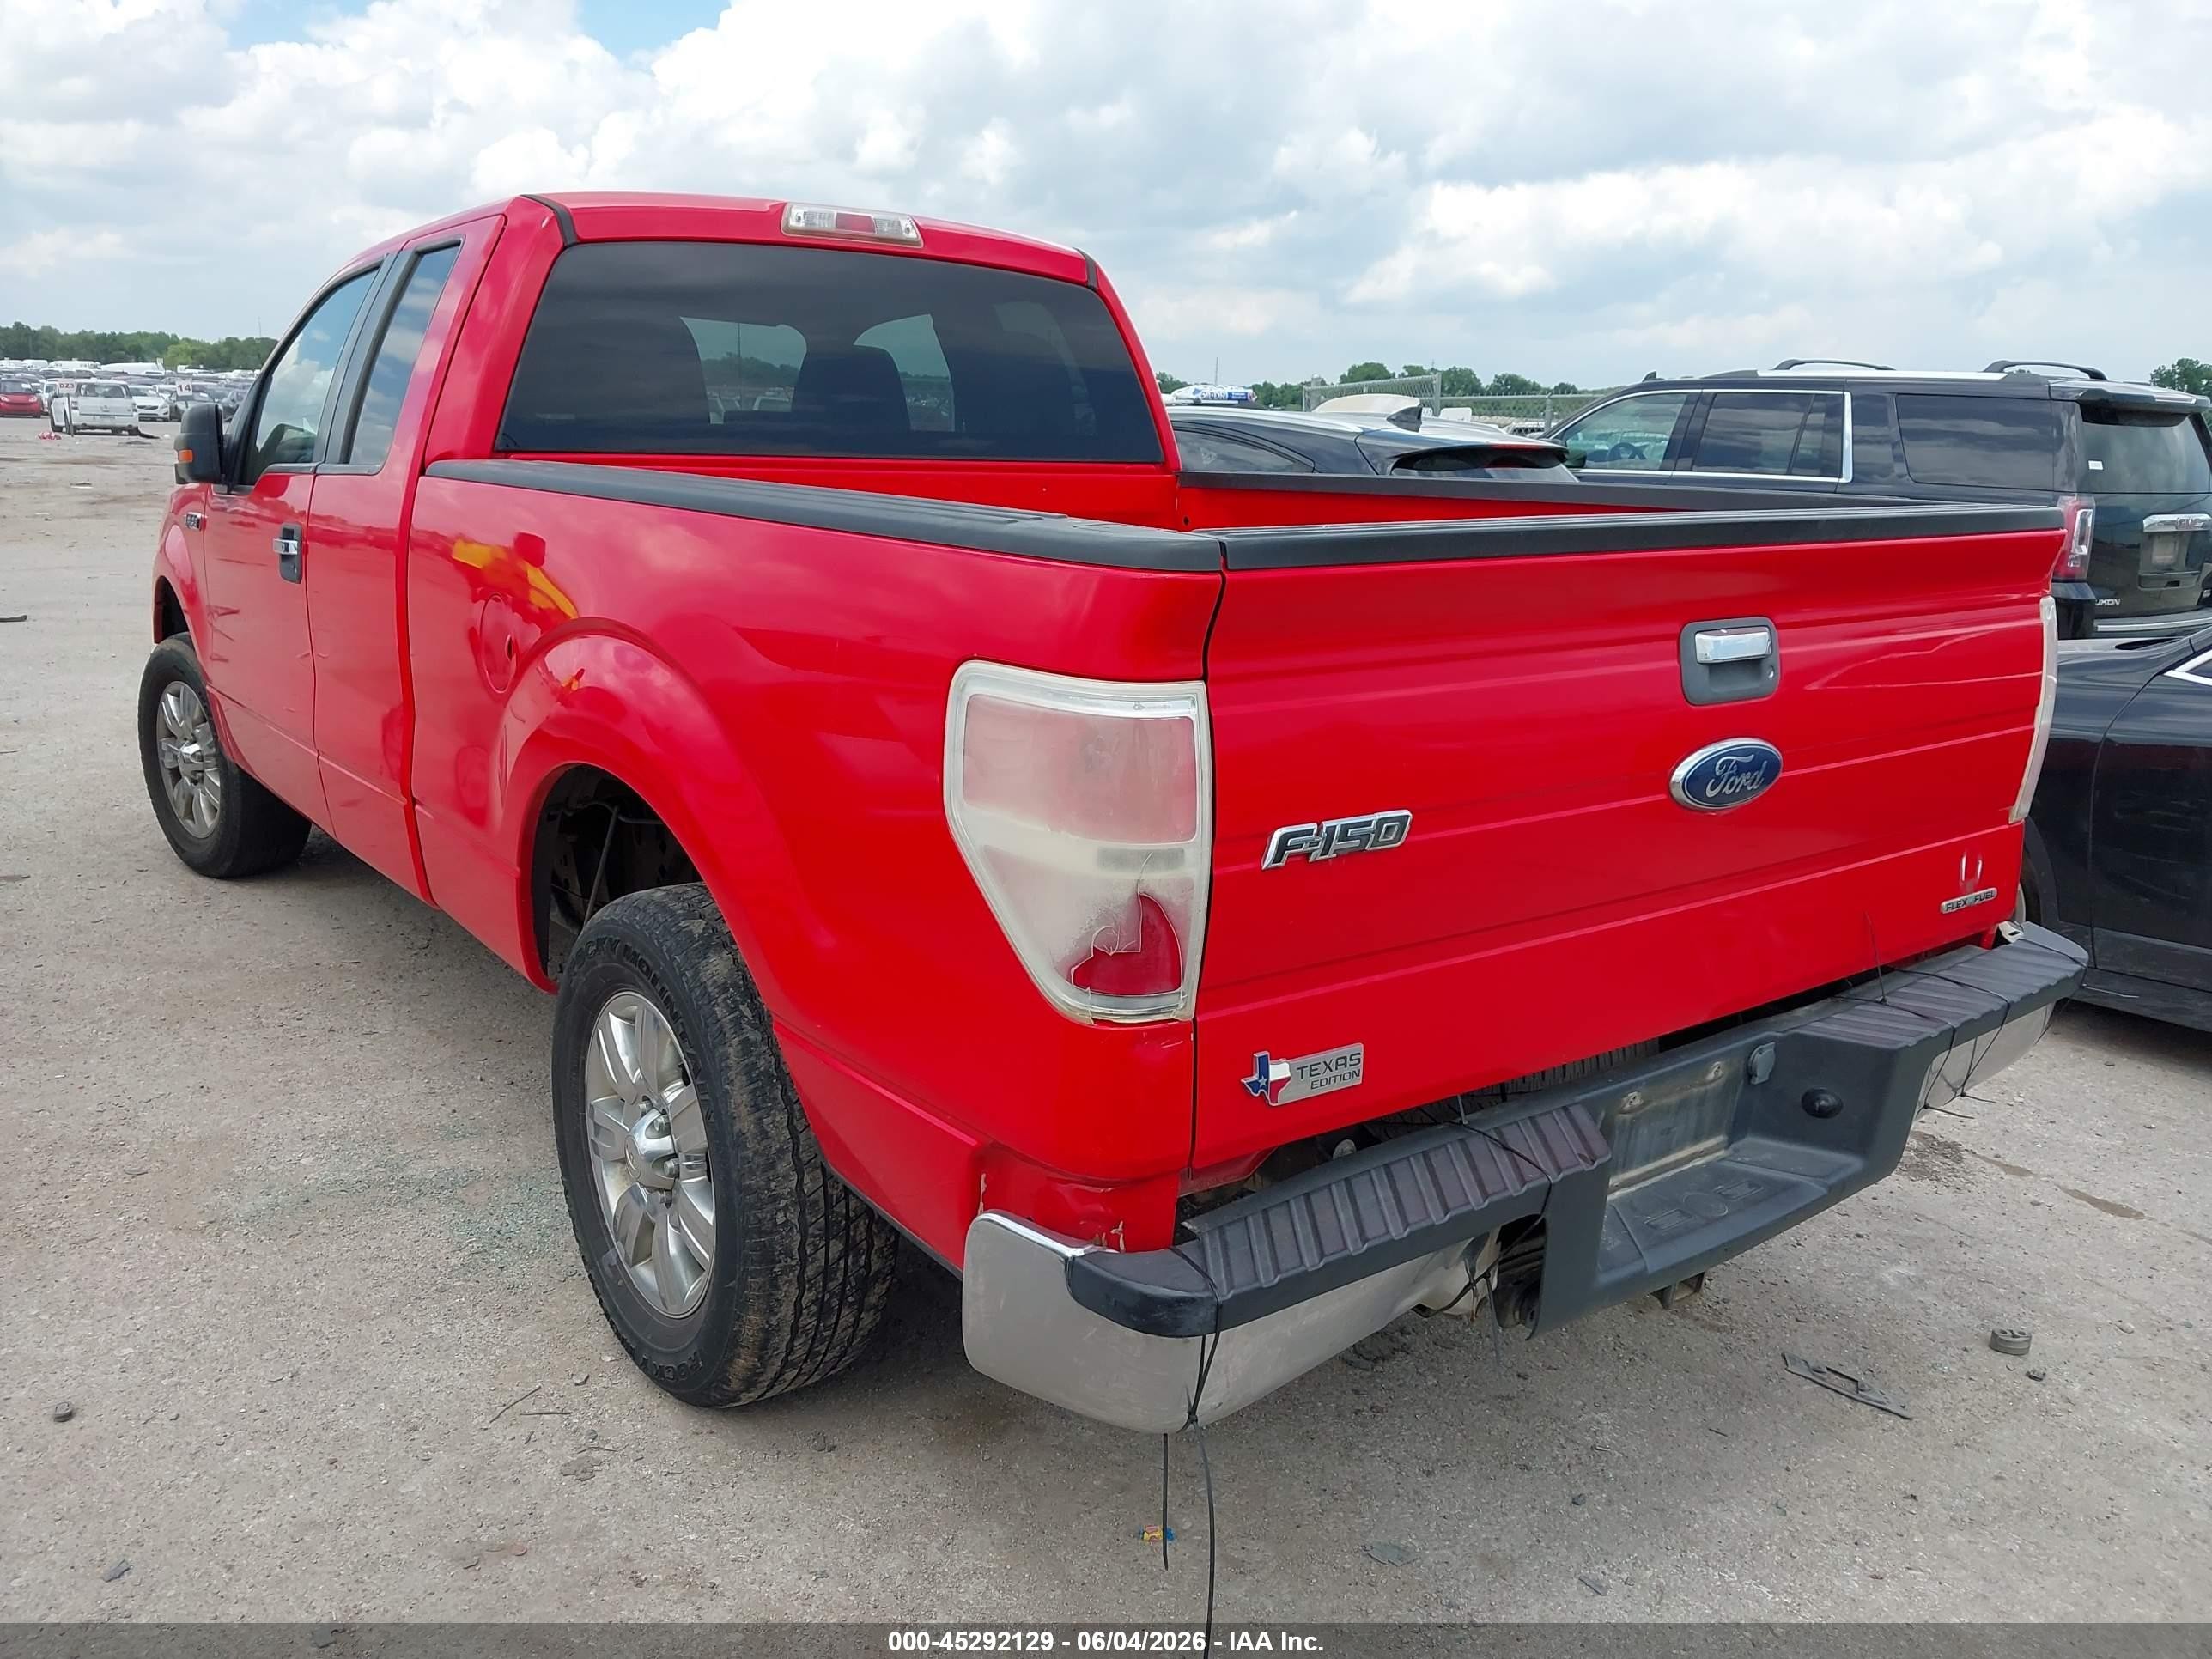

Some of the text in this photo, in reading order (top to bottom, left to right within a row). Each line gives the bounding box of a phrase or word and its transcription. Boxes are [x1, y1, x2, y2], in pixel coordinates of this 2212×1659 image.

[178, 384, 191, 392] 14
[1705, 754, 1768, 798] Ford
[1262, 810, 1413, 870] F-150
[1946, 890, 1995, 912] FLEX FUEL
[1297, 1052, 1361, 1079] TEXAS
[1310, 1068, 1361, 1090] EDITION
